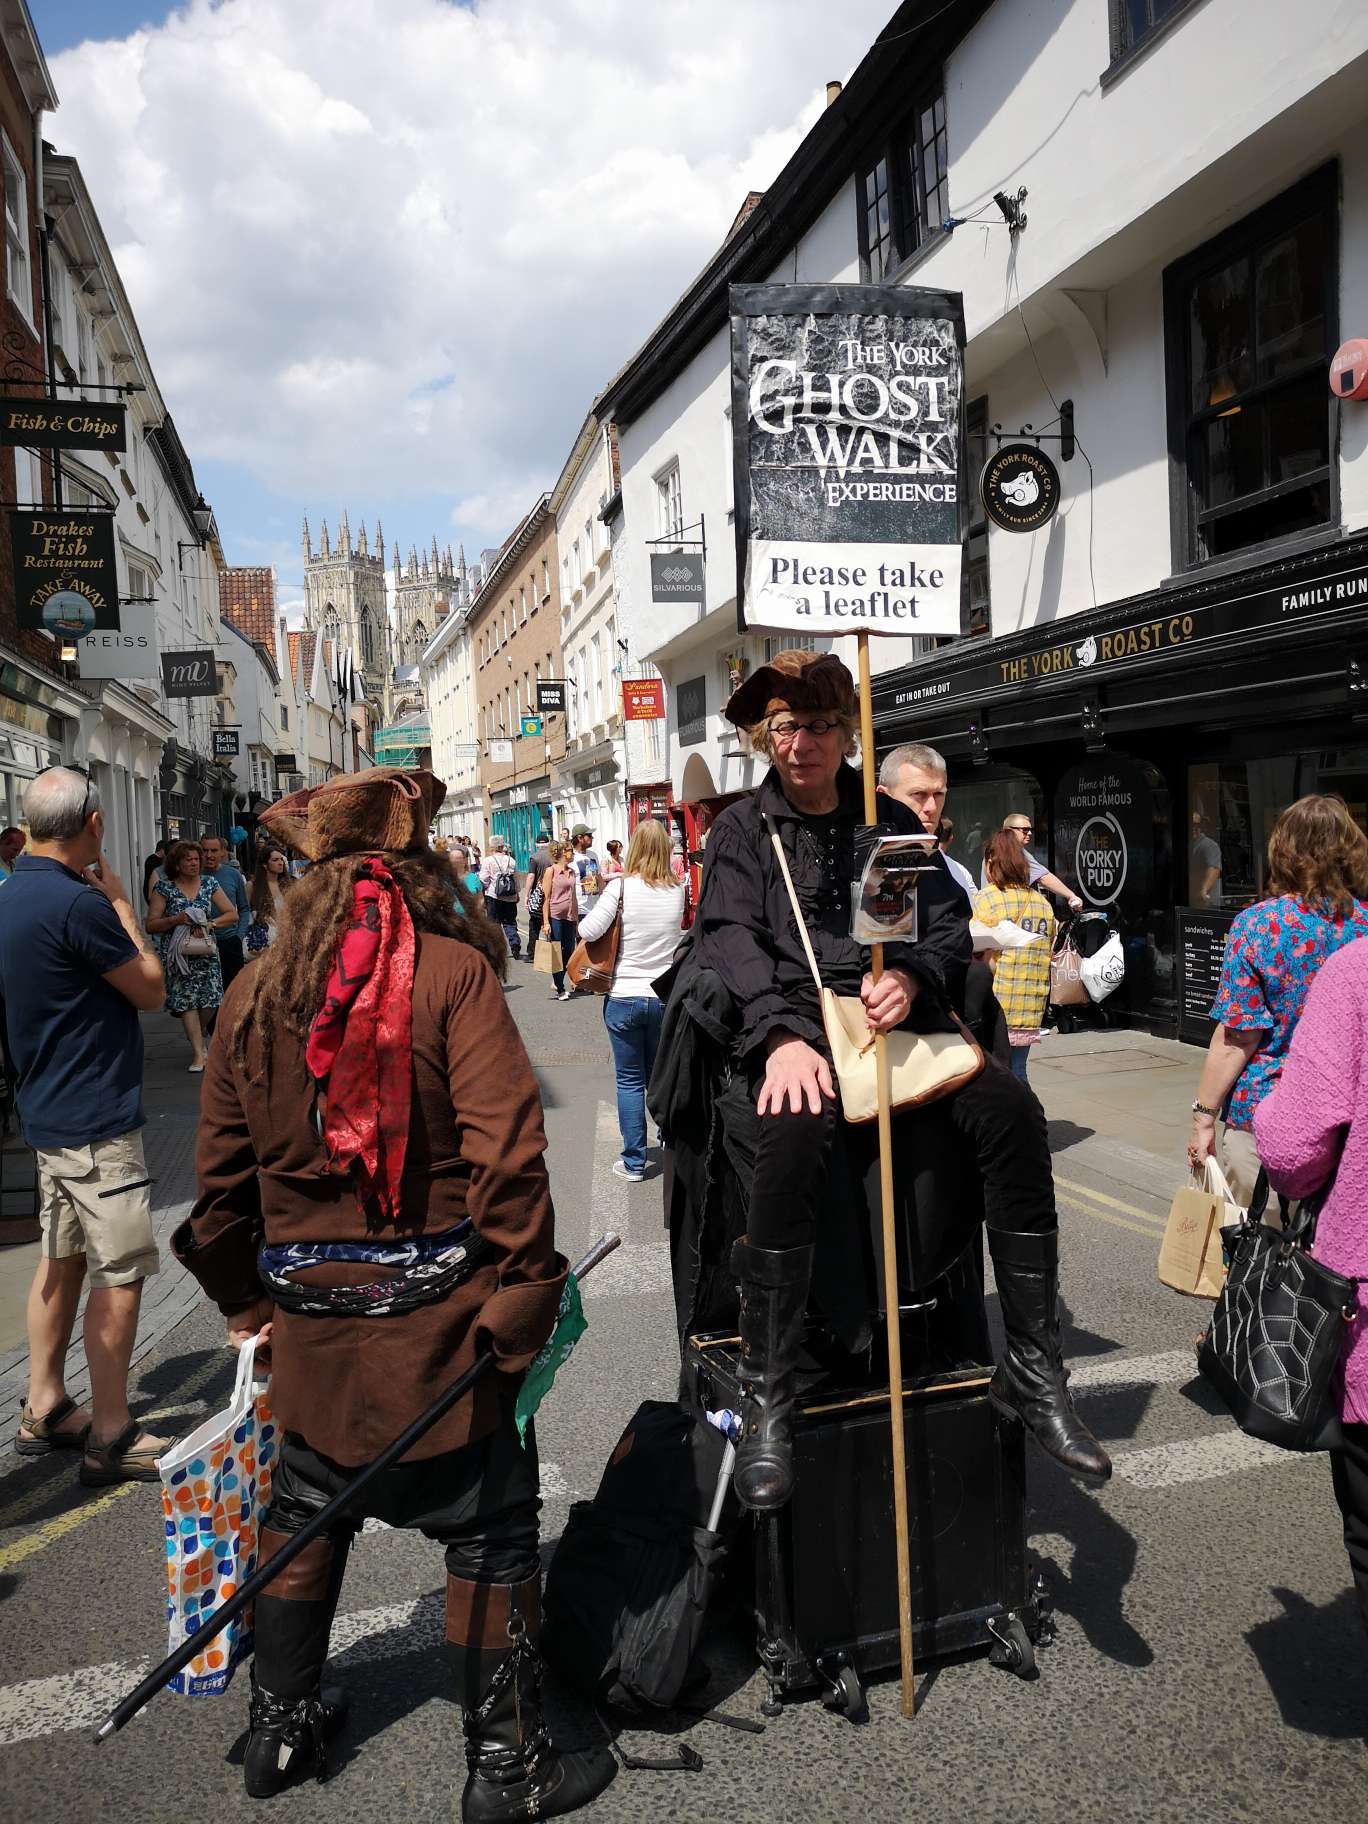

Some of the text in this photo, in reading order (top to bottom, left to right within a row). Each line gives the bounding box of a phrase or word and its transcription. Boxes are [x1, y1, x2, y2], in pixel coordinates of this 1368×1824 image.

[749, 358, 949, 435] GHOST
[8, 413, 118, 438] Fish & Chips
[800, 423, 957, 479] WALK
[990, 468, 1000, 488] THE
[998, 454, 1020, 470] YORK
[1022, 454, 1048, 476] ROAST
[826, 482, 957, 507] EXPERIENCE
[31, 521, 94, 536] Drakes
[42, 538, 88, 556] Fish
[24, 556, 104, 568] Restaurant
[769, 558, 944, 588] Please take
[30, 578, 108, 608] TAKE AWAY
[796, 590, 920, 618] a leaflet
[1282, 578, 1368, 612] FAMILY RUN
[86, 636, 148, 648] REISS
[1001, 659, 1028, 683] THE
[1032, 646, 1074, 675] YORK
[1102, 623, 1162, 660] ROAST
[896, 682, 950, 704] EAT IN OR TAKE OUT
[216, 734, 236, 743] Bella
[216, 744, 236, 752] Italia
[1078, 775, 1120, 794] Home of the
[1070, 793, 1132, 808] WORLD FAMOUS
[1080, 850, 1122, 868] YORKY
[1185, 926, 1213, 936] sandwiches
